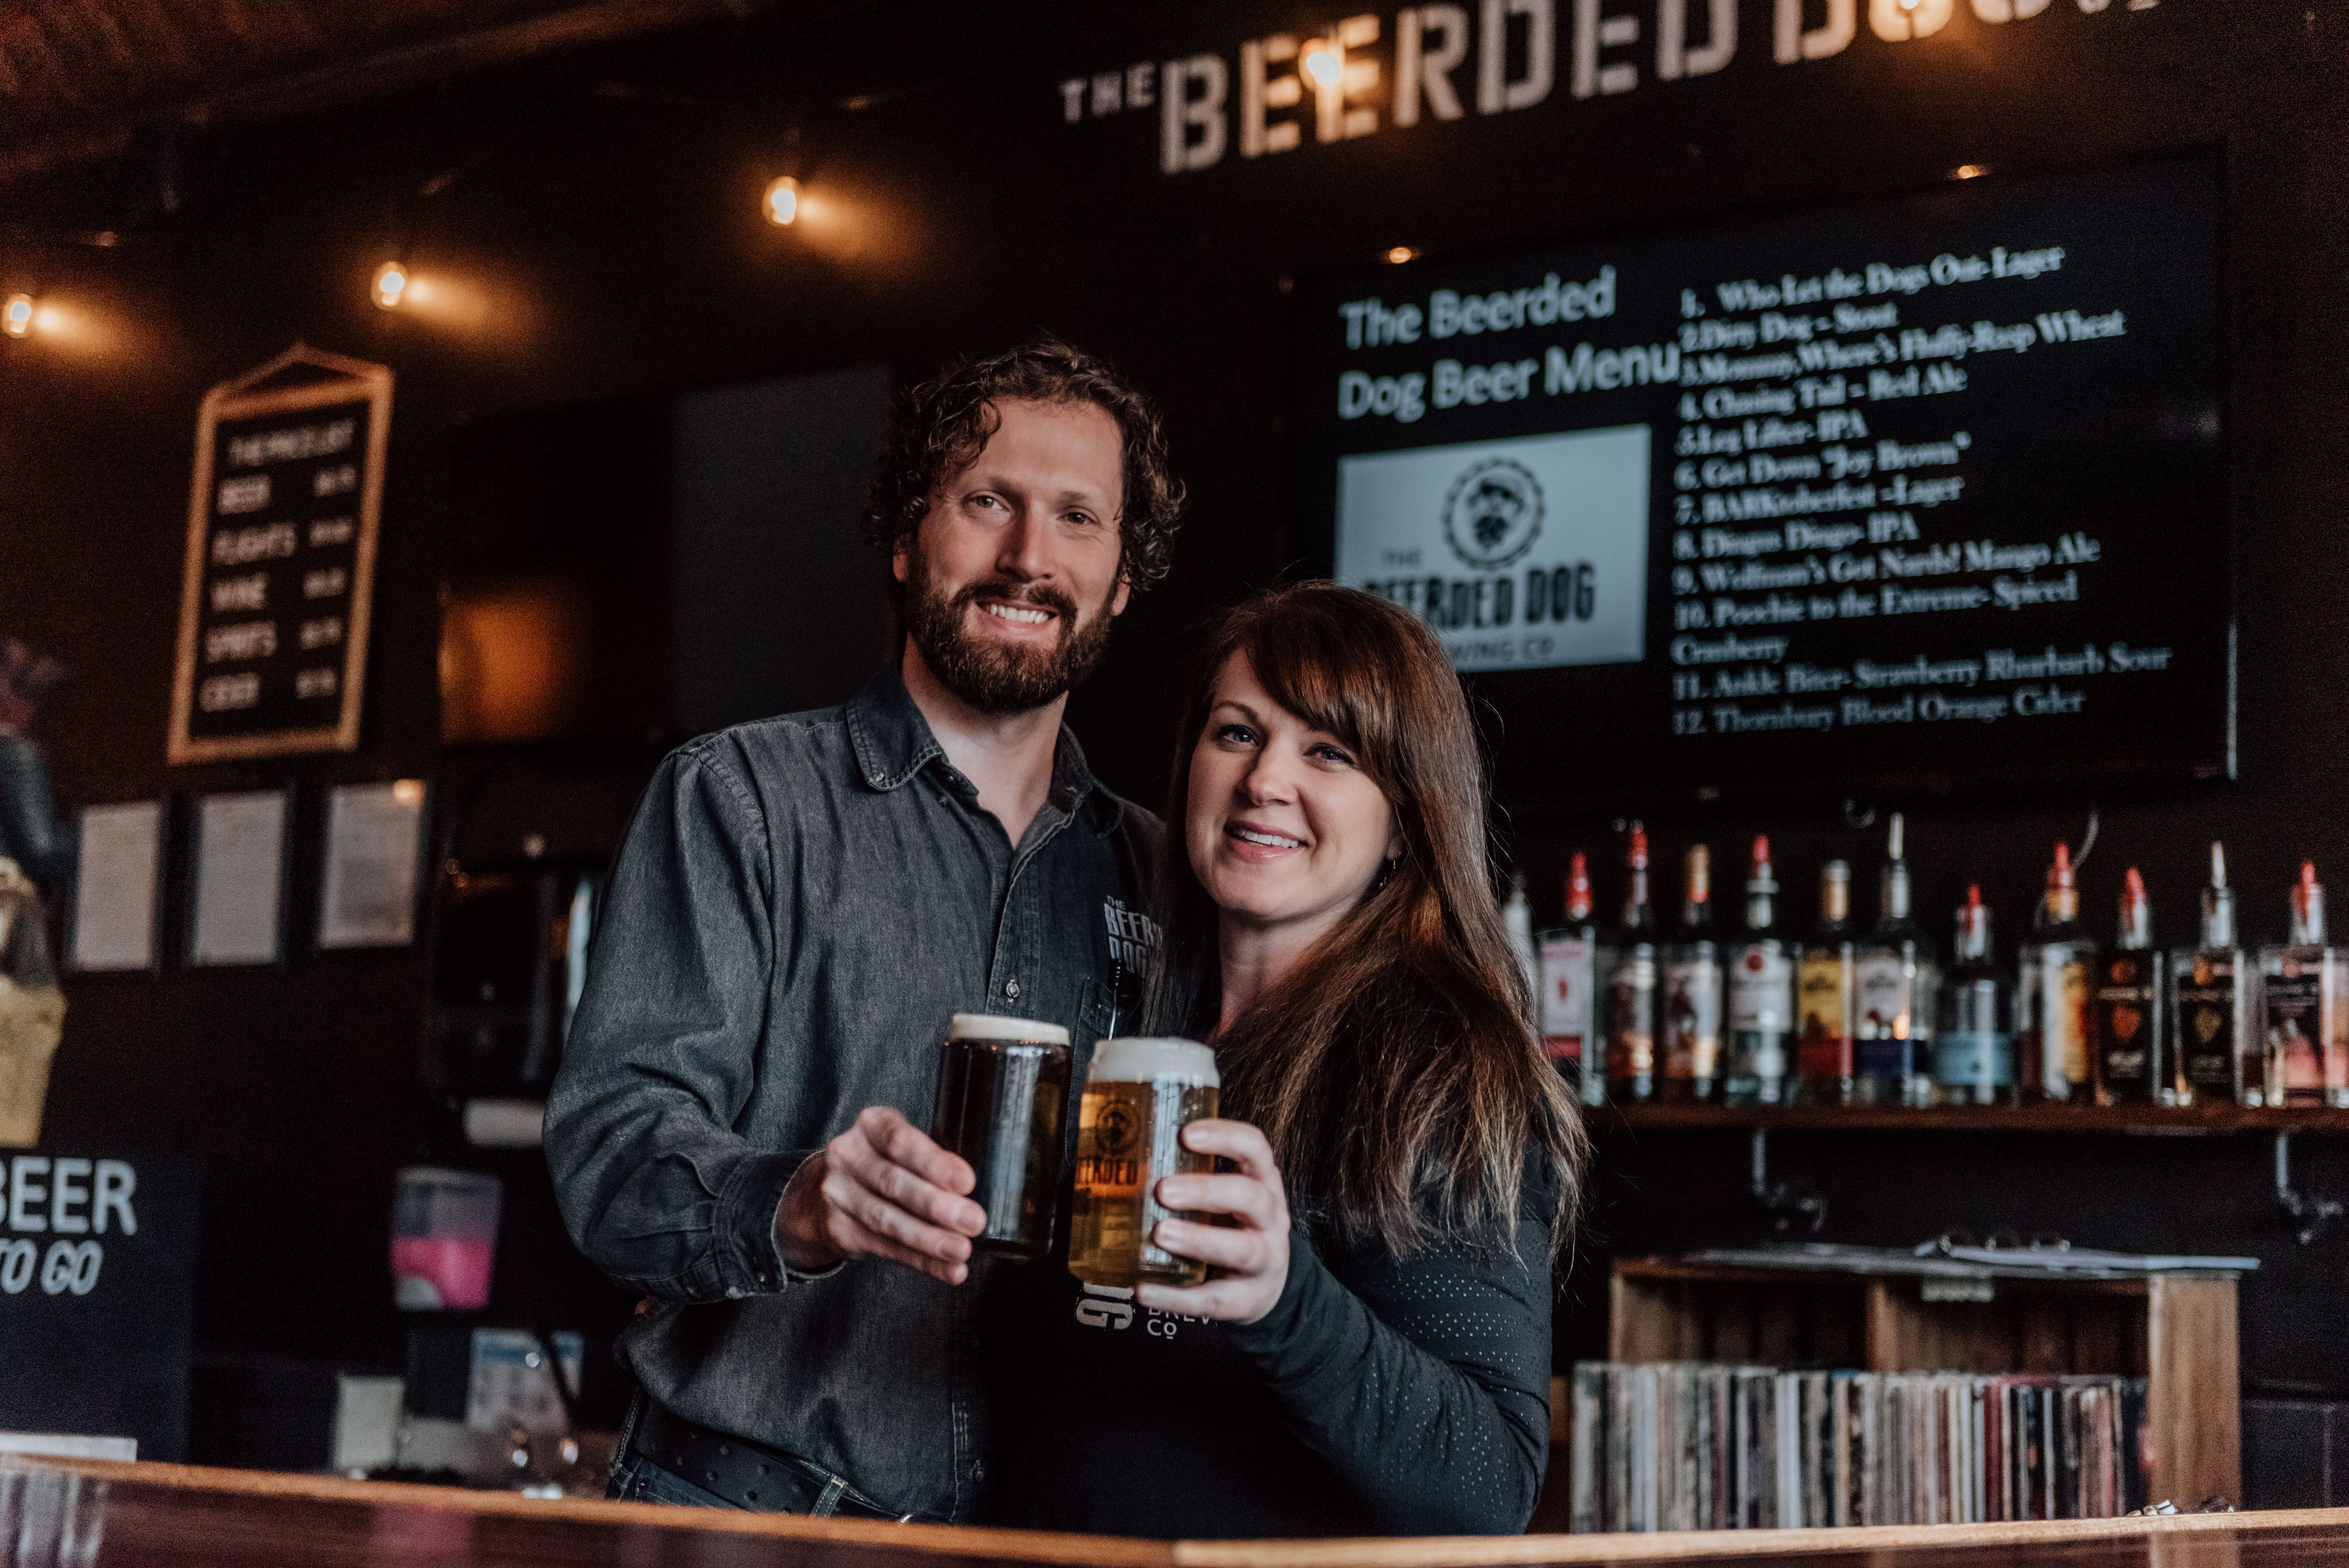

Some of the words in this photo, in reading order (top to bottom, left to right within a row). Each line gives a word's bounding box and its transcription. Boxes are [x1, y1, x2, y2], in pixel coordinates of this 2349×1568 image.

[1059, 60, 1156, 125] THE
[1160, 0, 1739, 175] BEERDED
[1338, 296, 1423, 349] The
[1429, 264, 1617, 339] Beerded
[1716, 279, 1781, 313] Who
[1780, 274, 1823, 306] Let
[1823, 267, 1866, 298] the
[1866, 261, 1931, 295] Dogs
[1992, 246, 2064, 279] Lager
[1760, 311, 1813, 343] Dog
[1834, 302, 1898, 333] Stout
[2037, 309, 2126, 342] Wheat
[1338, 370, 1426, 423] Dog
[1432, 358, 1539, 409] Beer
[1544, 342, 1680, 395] Menu
[1703, 383, 1795, 420] Chasing
[1799, 374, 1846, 408] Tail
[1869, 368, 1919, 402] Red
[1921, 364, 1968, 396] Ale
[1816, 409, 1869, 442] IPA
[1703, 454, 1750, 486] Get
[1749, 450, 1821, 484] Down
[1868, 512, 1920, 544] IPA
[1699, 553, 1826, 592] Wolfman's
[1828, 549, 1876, 583] Got
[1963, 539, 2051, 574] Mango
[2052, 532, 2101, 565] Ale
[1526, 558, 1597, 624] DOG
[1712, 595, 1807, 627] Poochie
[1809, 596, 1837, 622] to
[1837, 591, 1877, 618] the
[1992, 570, 2078, 610] Spiced
[1670, 633, 1788, 666] Cranberry
[1713, 666, 1781, 698] Ankle
[1853, 654, 1983, 689] Strawberry
[1985, 644, 2105, 682] Rhubarb
[2108, 643, 2172, 673] Sour
[1712, 703, 1836, 734] Thornbury
[1840, 693, 1915, 727] Blood
[1918, 691, 2009, 725] Orange
[2012, 685, 2087, 717] Cider
[0, 1156, 138, 1236] EER
[40, 1239, 103, 1295] GO
